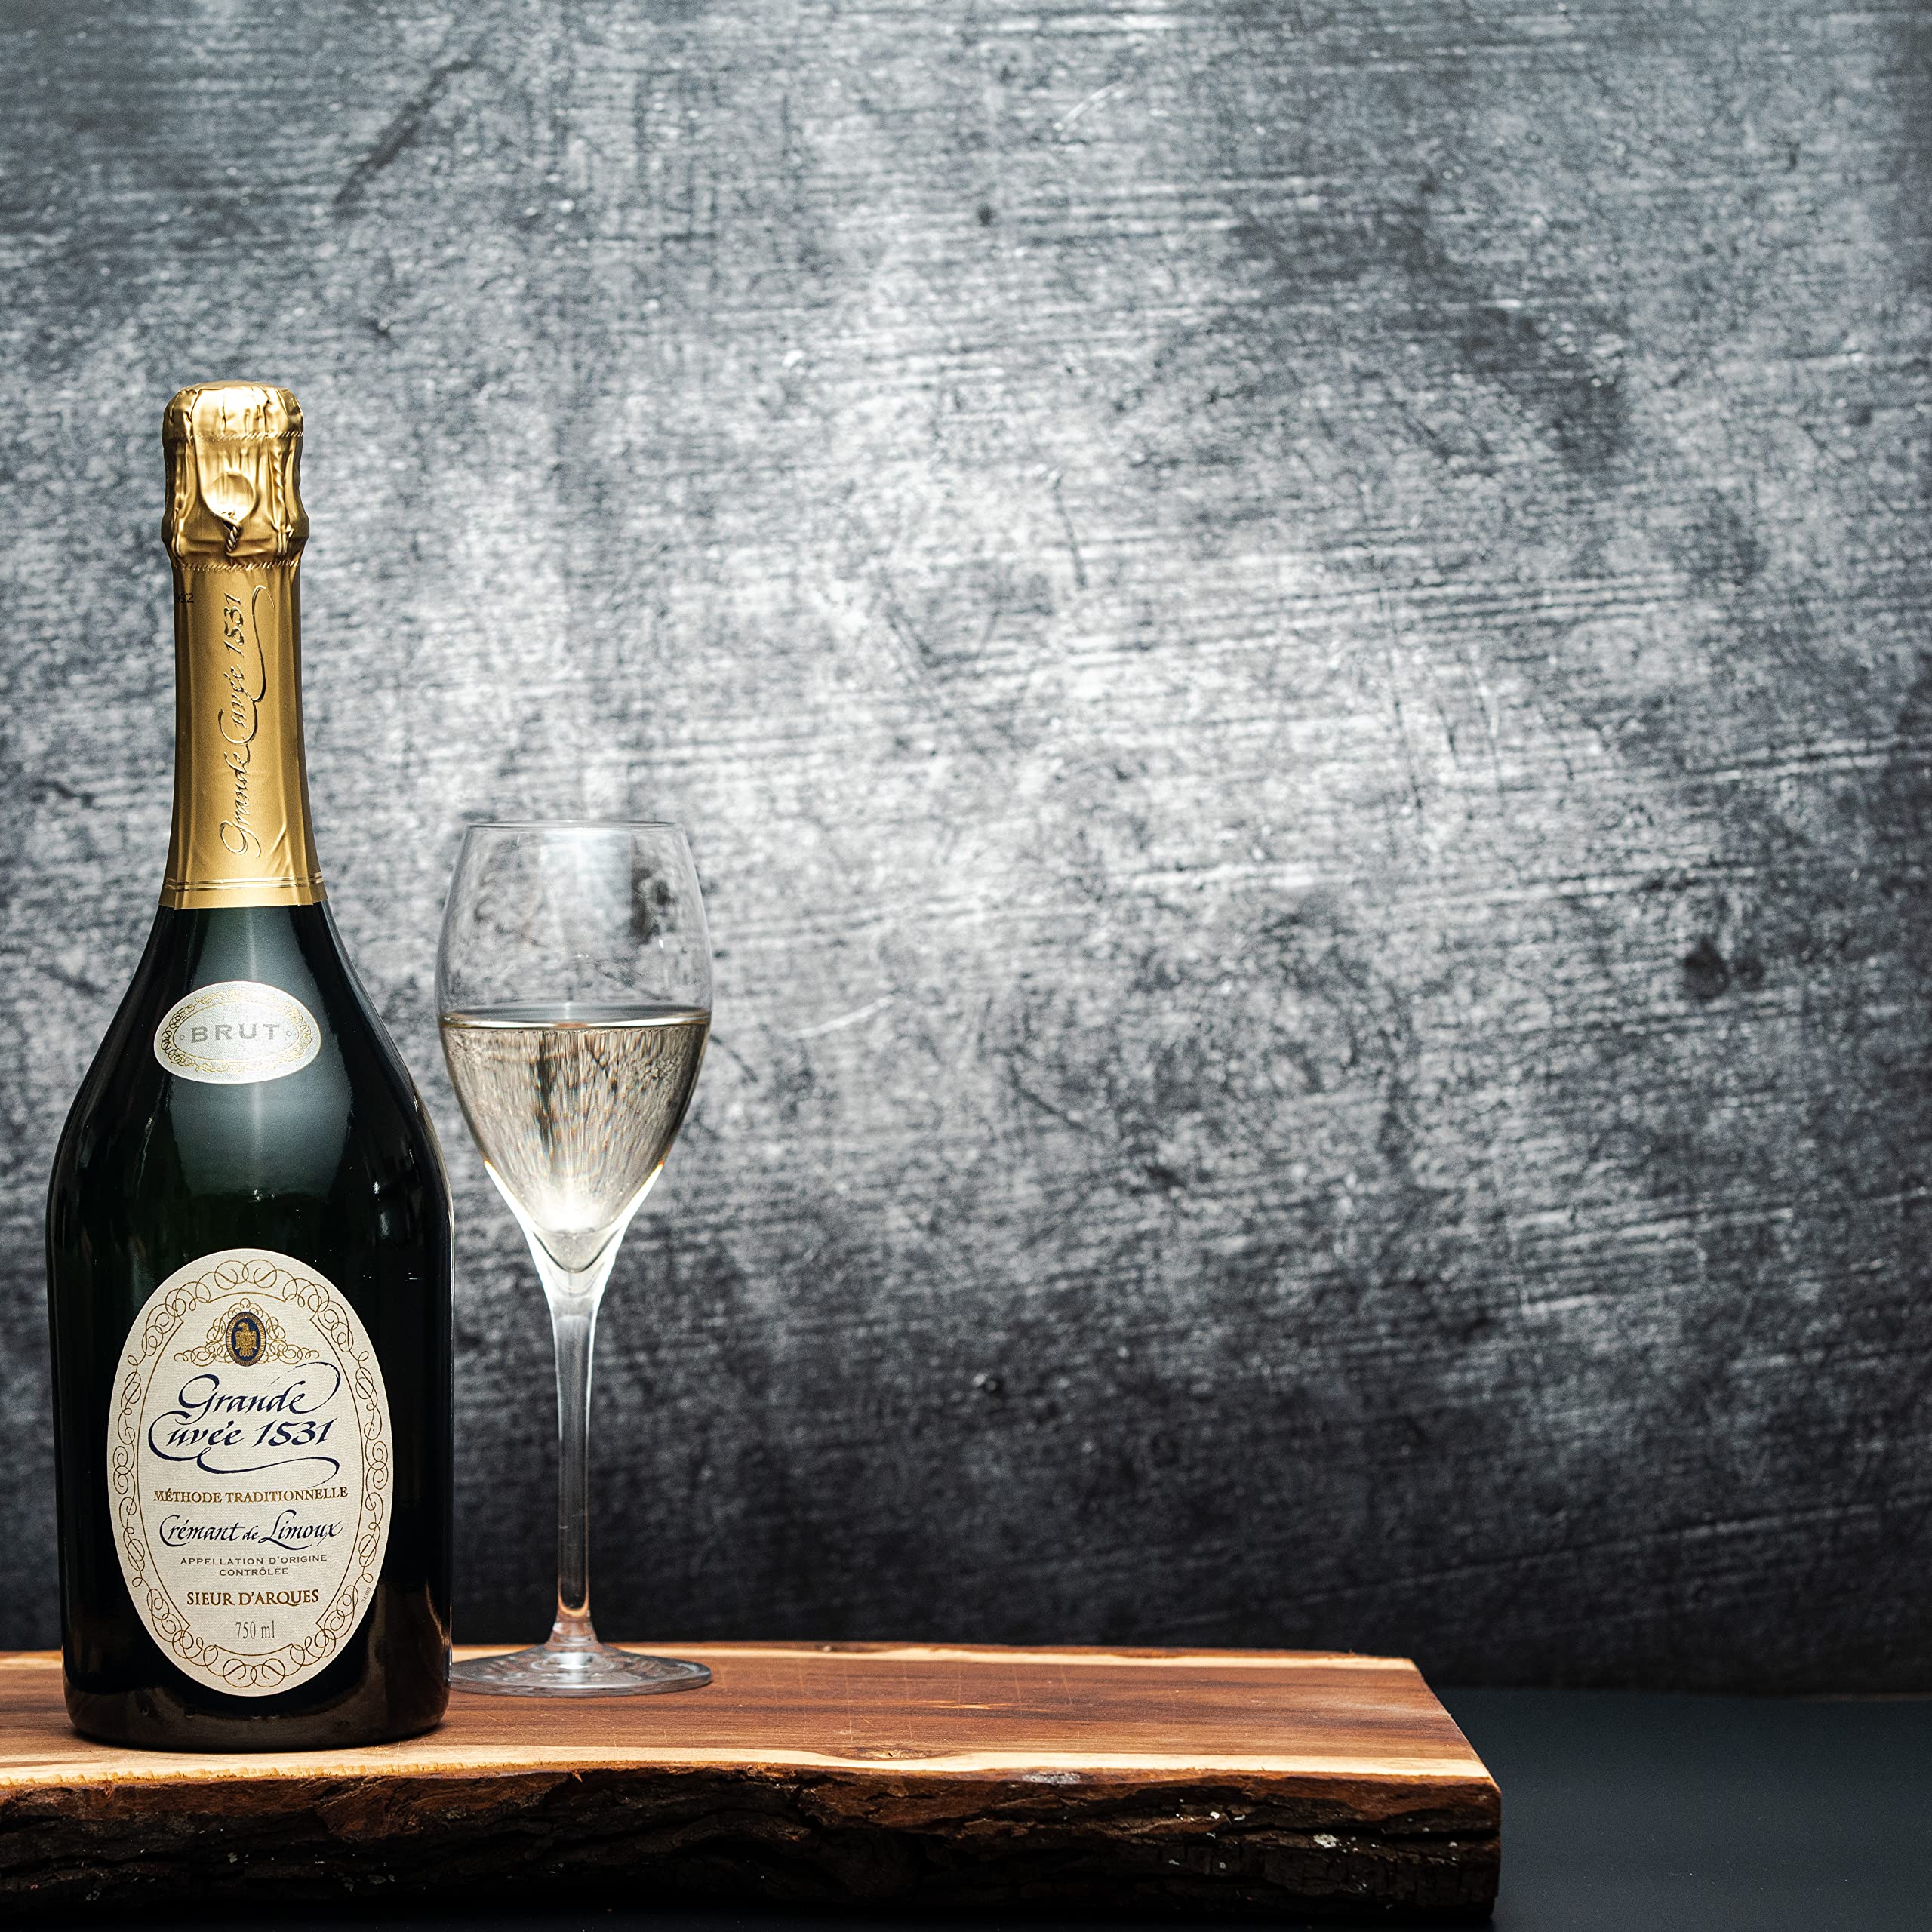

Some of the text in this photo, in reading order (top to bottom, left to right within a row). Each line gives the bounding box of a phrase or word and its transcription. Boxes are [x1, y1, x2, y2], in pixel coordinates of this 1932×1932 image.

[223, 592, 245, 657] 1531
[219, 744, 260, 858] Grande
[191, 1023, 279, 1043] BRUT
[175, 1362, 340, 1425] Grande
[251, 1417, 338, 1448] 1531
[153, 1487, 348, 1503] MÉTHODE TRADITIONNELLE
[159, 1509, 343, 1551] Crémant de Limoux
[269, 1555, 328, 1564] D'ORIGINE
[219, 1566, 289, 1577] CONTRÔLÉE
[186, 1589, 319, 1607] SIEUR D'ARQUES
[235, 1620, 275, 1639] 750 ml
